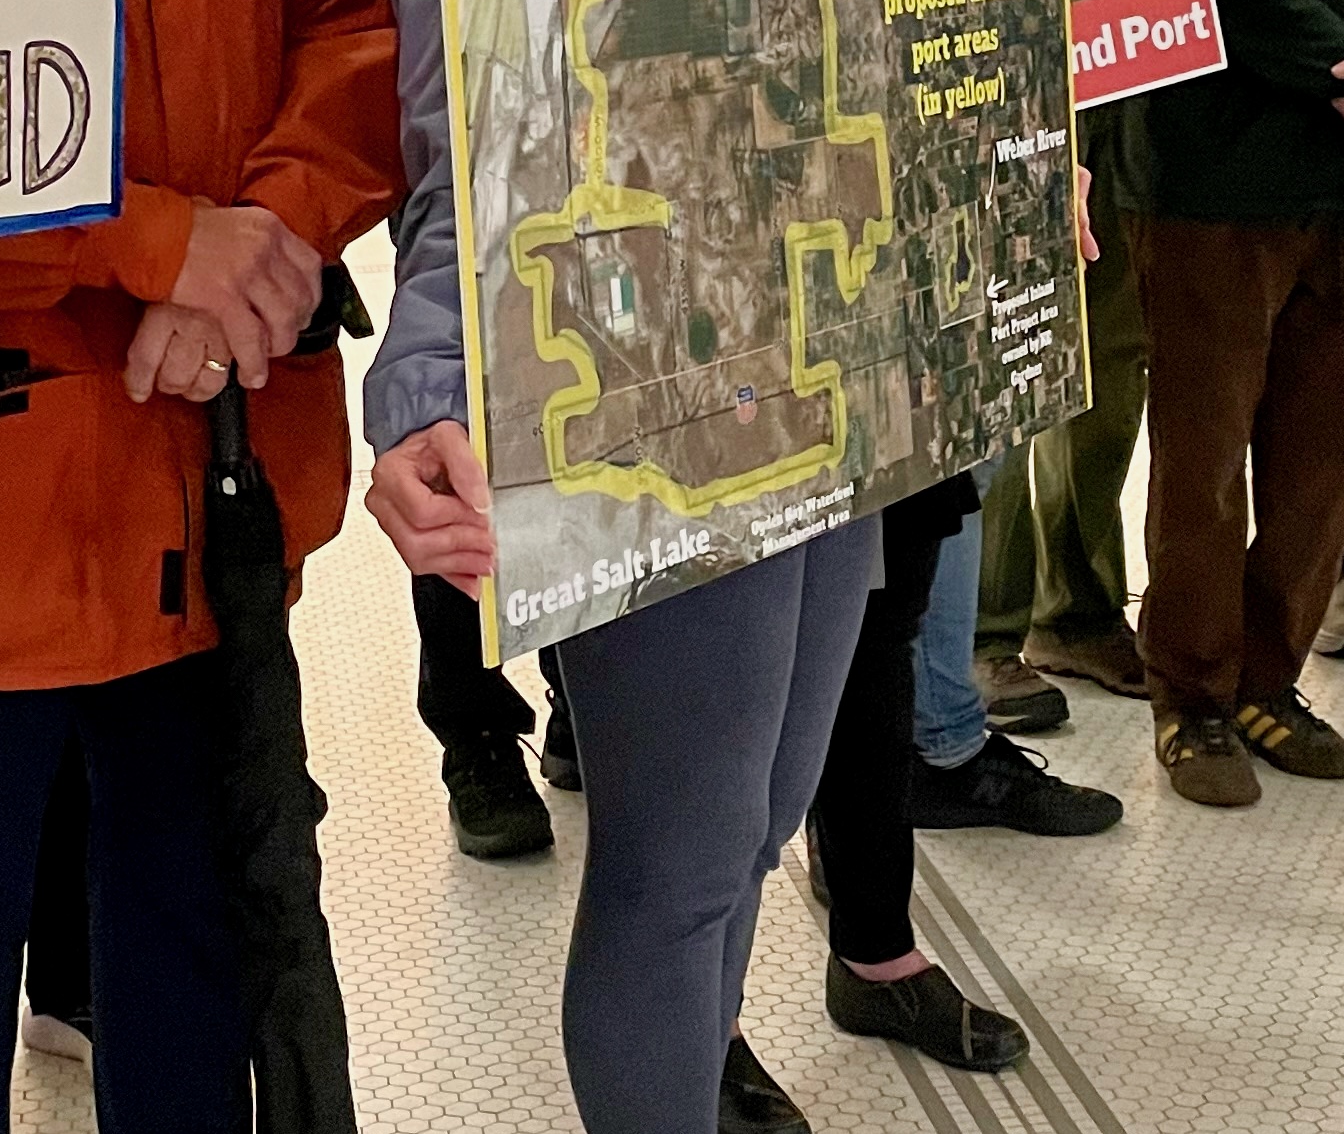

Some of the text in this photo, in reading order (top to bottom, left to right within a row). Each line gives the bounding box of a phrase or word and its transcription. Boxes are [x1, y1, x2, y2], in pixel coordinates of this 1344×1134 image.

[911, 26, 999, 75] port areas
[1121, 1, 1211, 59] Port
[916, 66, 1006, 126] (in yellow)
[996, 128, 1067, 164] Weber River
[506, 527, 710, 627] Great Salt Lake
